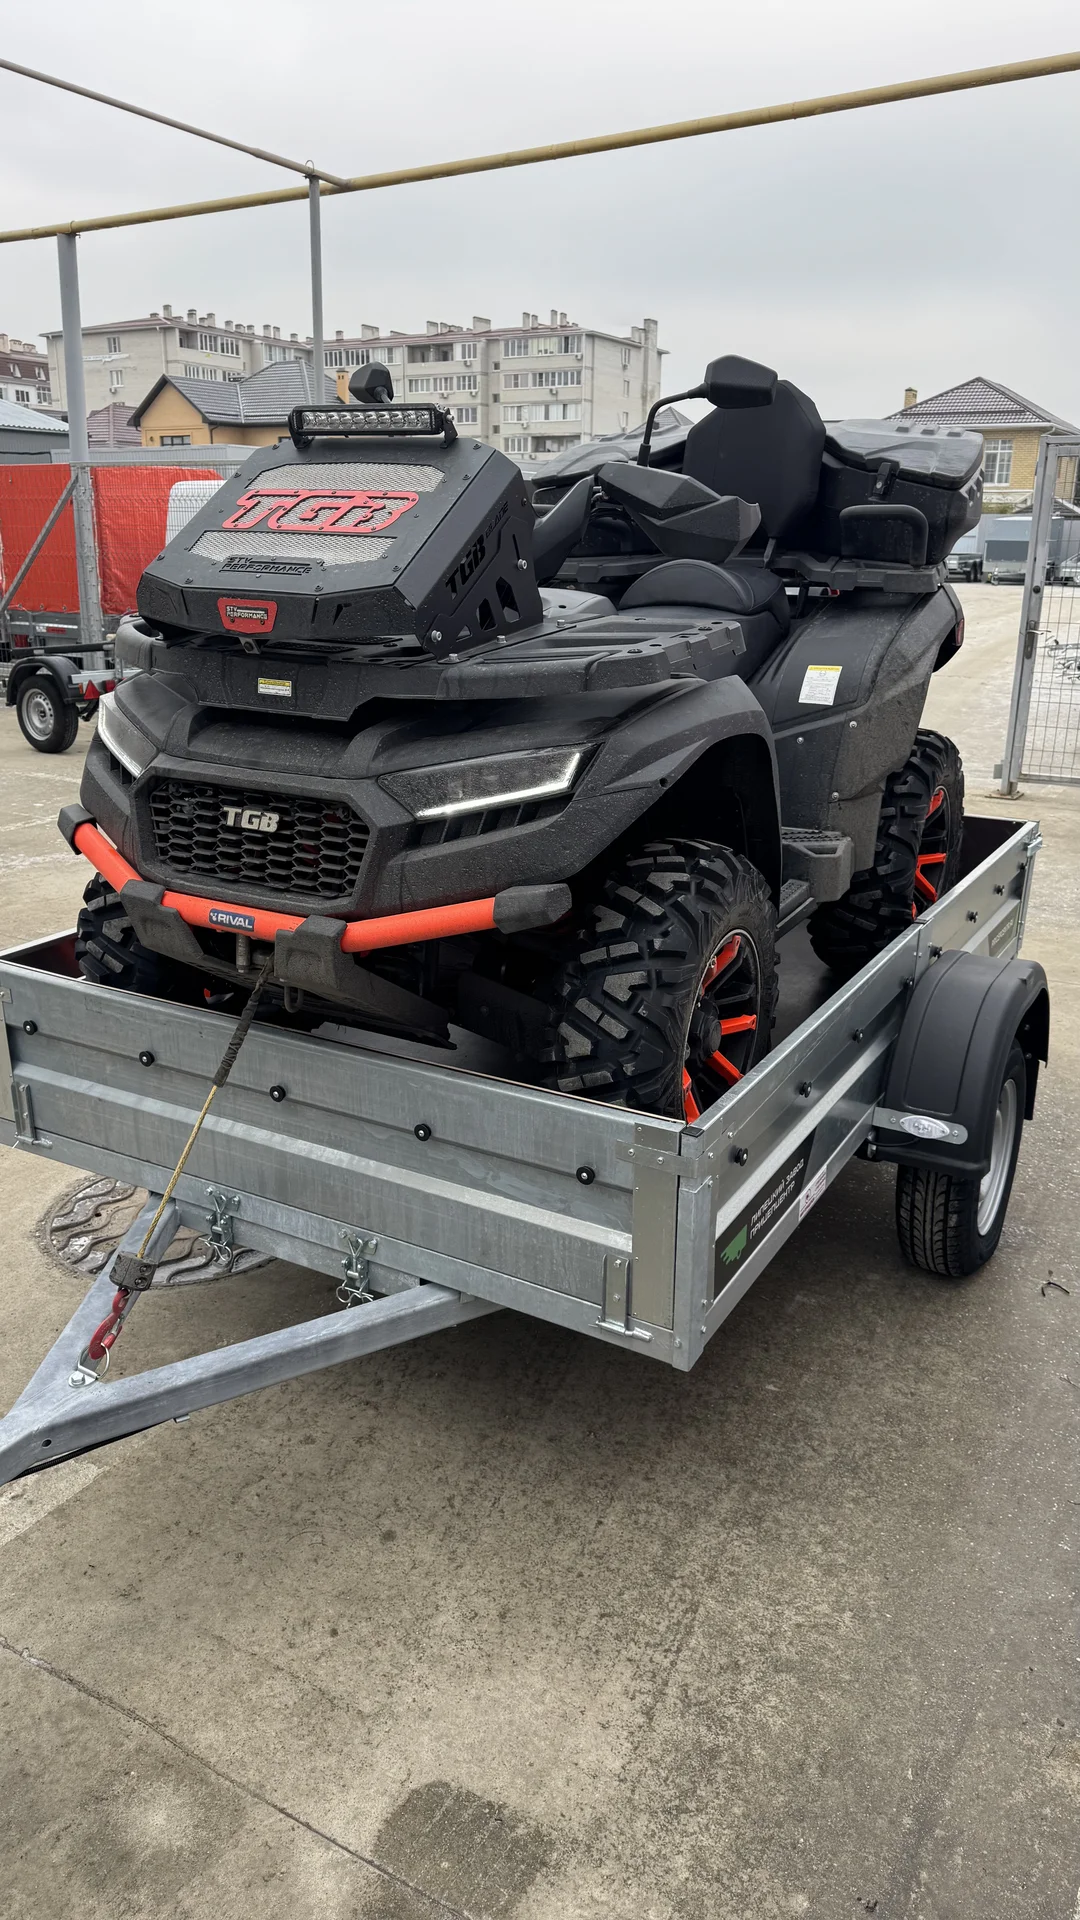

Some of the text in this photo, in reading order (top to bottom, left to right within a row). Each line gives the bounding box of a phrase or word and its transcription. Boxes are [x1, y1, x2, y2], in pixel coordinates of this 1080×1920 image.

[222, 489, 419, 533] TGB
[221, 563, 312, 574] PERFORMANCE
[445, 534, 485, 594] TGB
[226, 611, 267, 620] PERFORMANCE
[223, 806, 280, 833] TGB
[218, 913, 253, 928] RIVAL
[750, 1180, 796, 1239] ПРИЦЕПЦЕНТР
[751, 1158, 804, 1226] ЛИПЕЦКИЙ ЗАВОД
